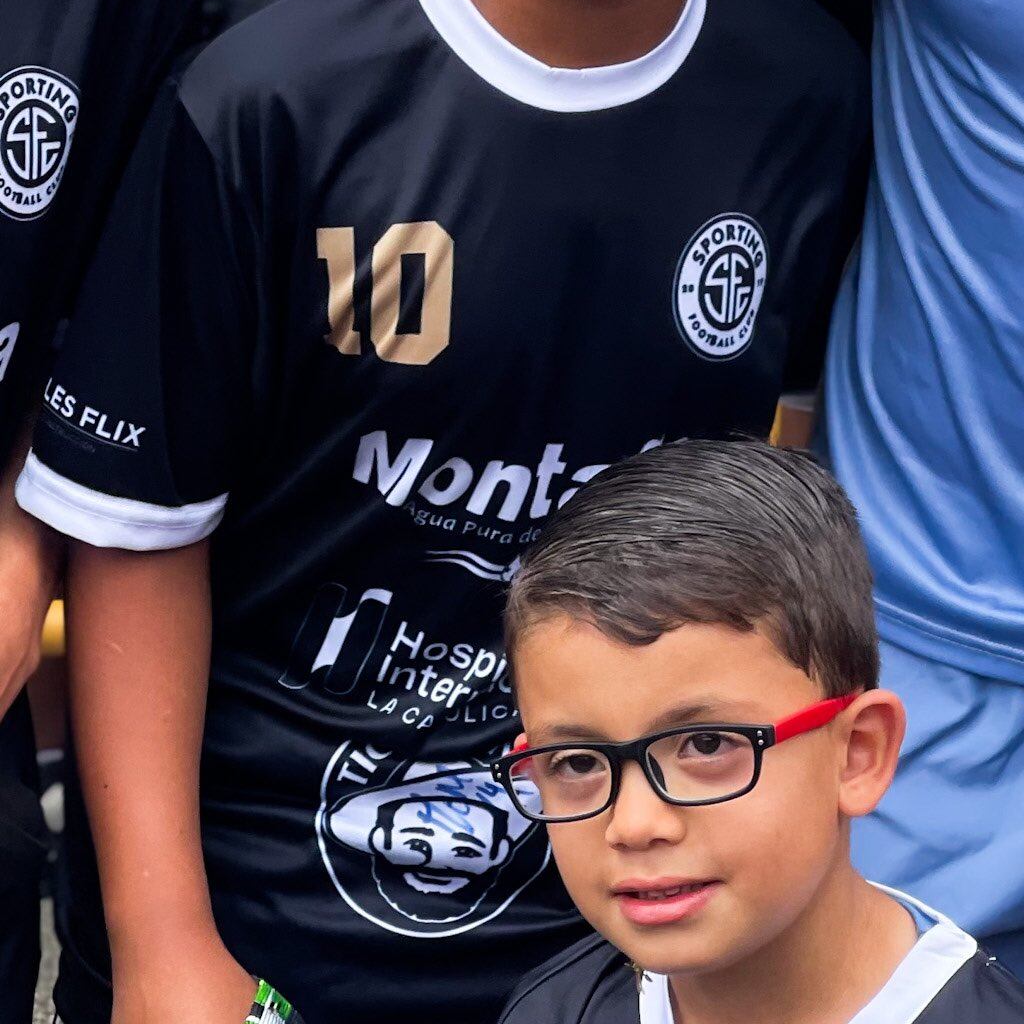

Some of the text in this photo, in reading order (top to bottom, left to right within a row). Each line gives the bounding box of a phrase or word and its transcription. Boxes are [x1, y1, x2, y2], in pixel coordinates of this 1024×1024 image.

[0, 173, 42, 205] OOTBALL
[692, 224, 764, 268] SPORTING
[316, 220, 454, 365] 10
[688, 313, 735, 348] FOOTBALL
[79, 406, 147, 447] FLIX
[352, 430, 662, 522] Mont
[404, 501, 541, 544] Agua Pura de
[367, 690, 398, 715] LA
